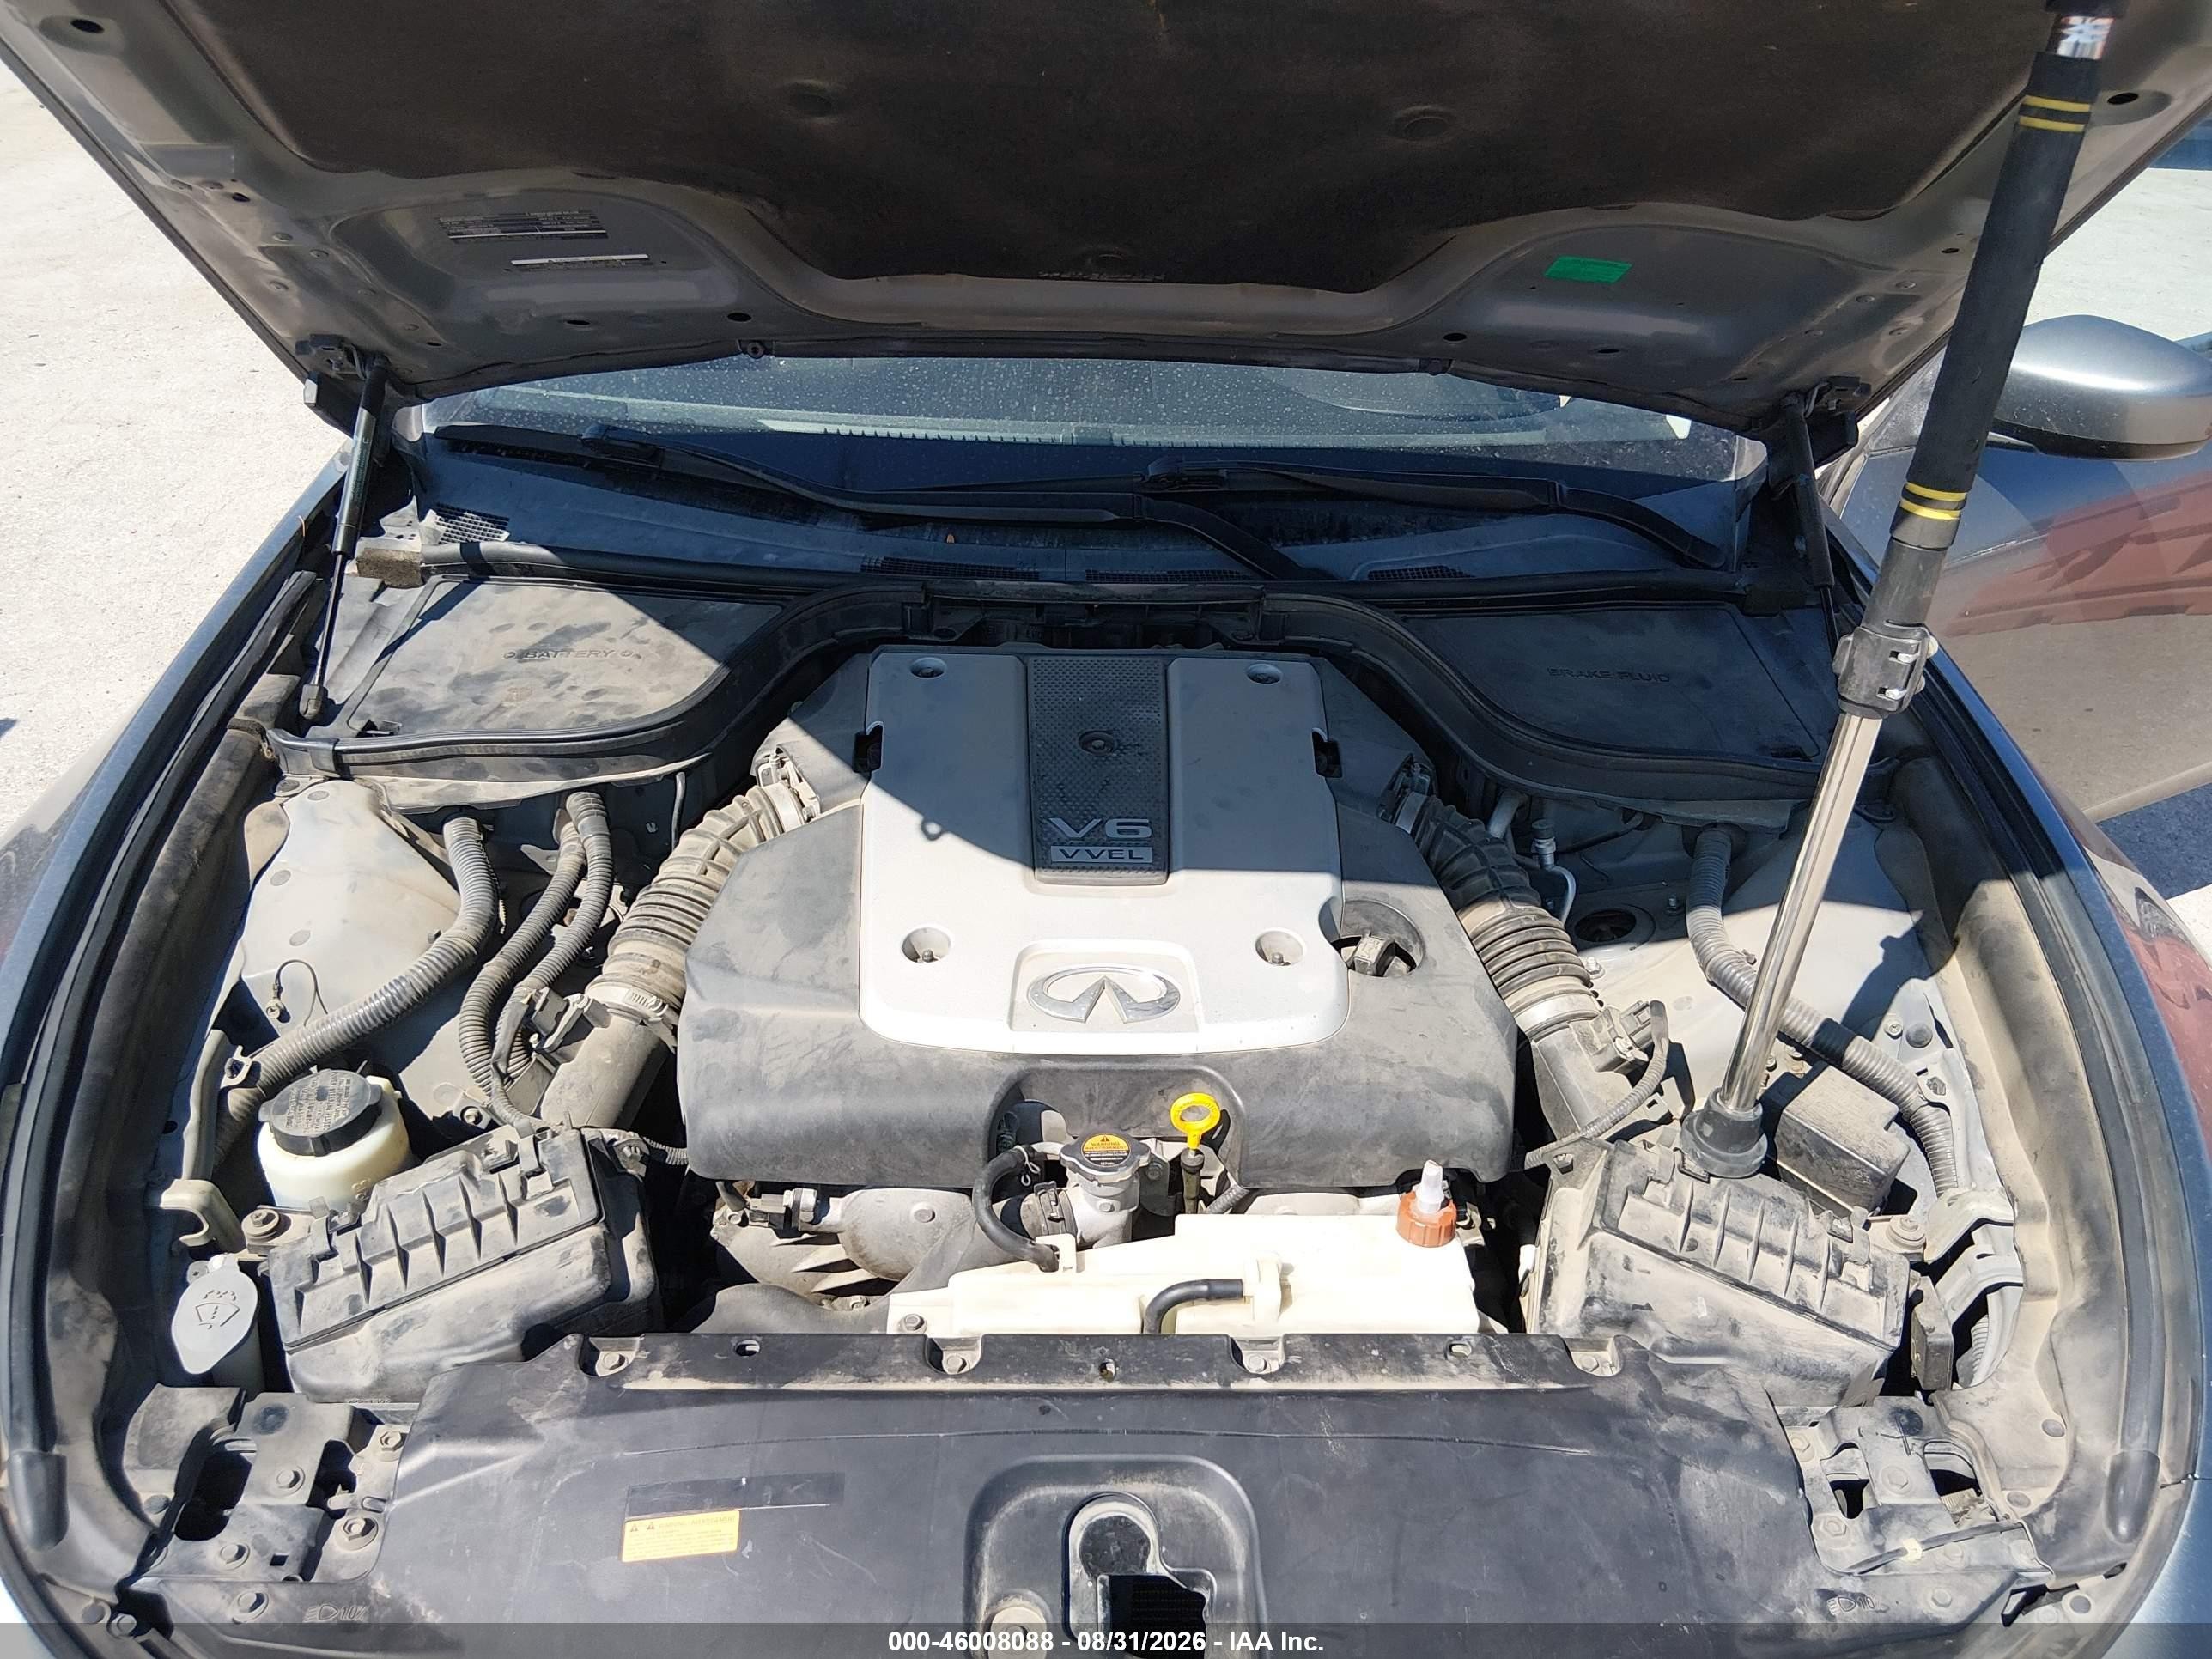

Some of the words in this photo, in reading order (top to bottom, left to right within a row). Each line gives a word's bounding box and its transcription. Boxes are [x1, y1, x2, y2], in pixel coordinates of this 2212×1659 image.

[525, 649, 615, 659] BATTERY
[1547, 666, 1613, 680] BRAKE
[1616, 670, 1670, 683] FLUID
[1048, 817, 1153, 839] V6
[1059, 848, 1145, 860] VVEL
